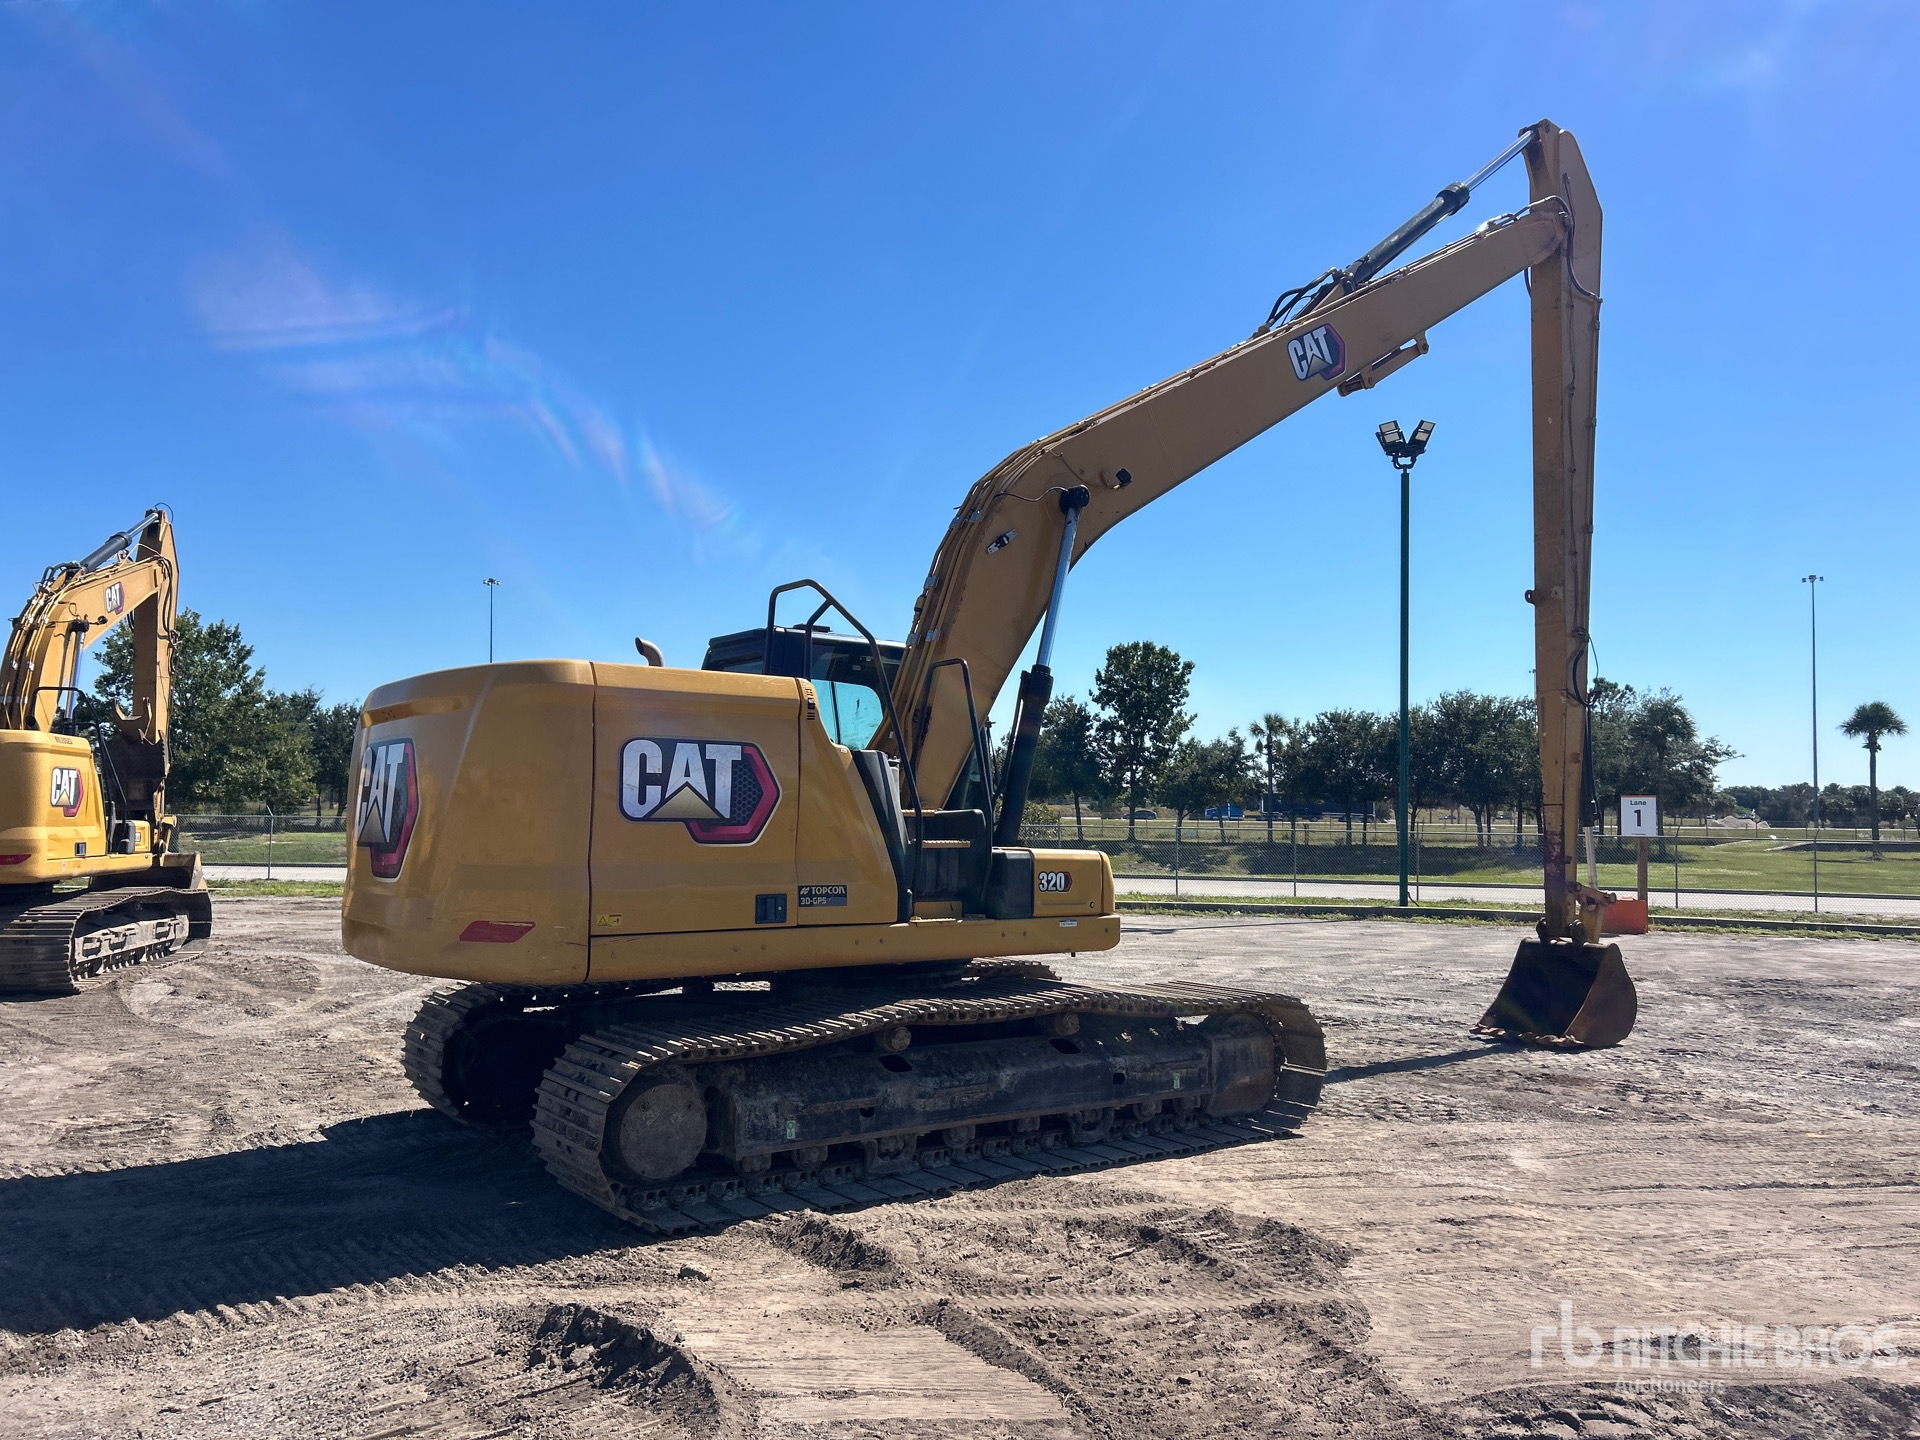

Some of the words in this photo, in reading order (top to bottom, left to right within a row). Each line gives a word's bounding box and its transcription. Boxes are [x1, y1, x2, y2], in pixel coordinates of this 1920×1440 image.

[1288, 326, 1333, 380] CAT
[105, 583, 121, 612] CAT
[51, 768, 78, 806] CAT
[353, 743, 406, 843] CAT
[622, 739, 742, 819] CAT
[1633, 809, 1642, 827] 1
[810, 886, 846, 895] TOPCON
[1038, 872, 1065, 892] 320
[800, 897, 827, 905] 3D-GPS
